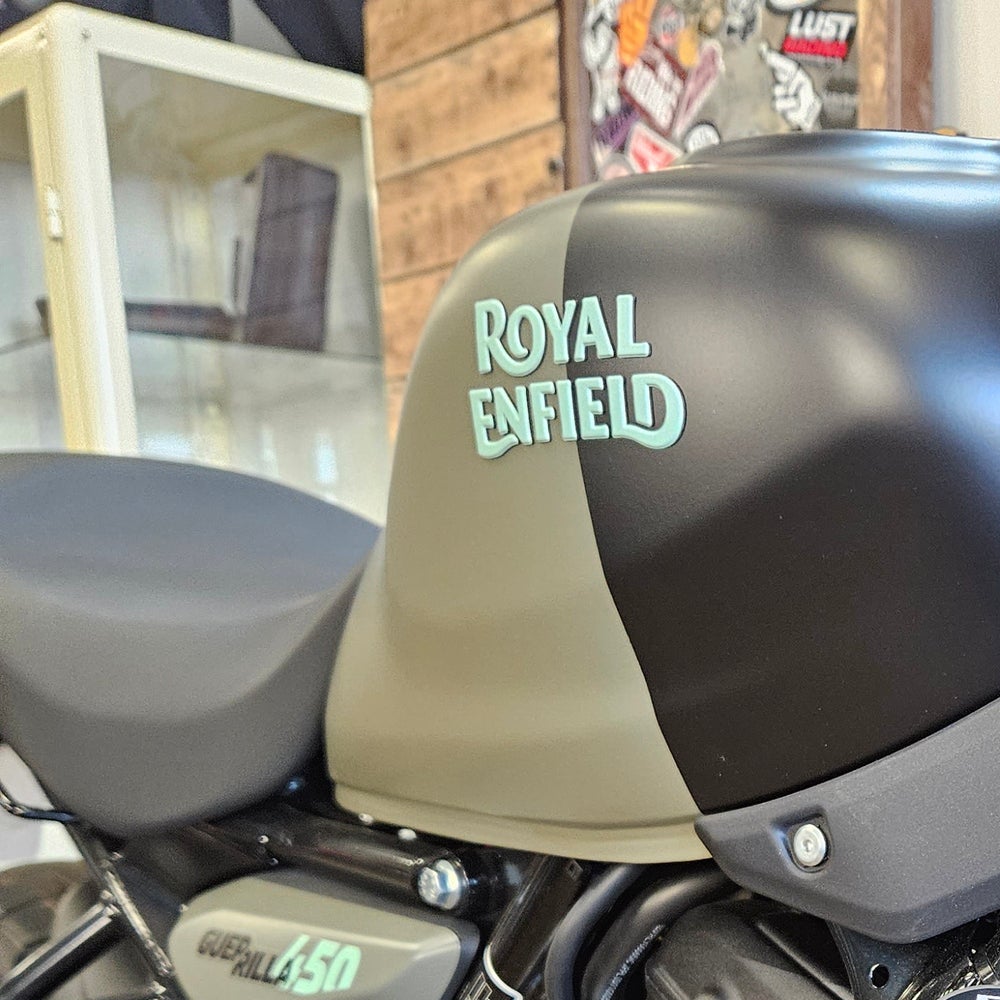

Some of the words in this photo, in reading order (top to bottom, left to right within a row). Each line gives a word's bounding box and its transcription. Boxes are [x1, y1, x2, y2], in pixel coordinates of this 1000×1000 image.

[475, 294, 651, 377] ROYAL
[469, 373, 687, 459] ENFIELD
[269, 934, 362, 995] 450
